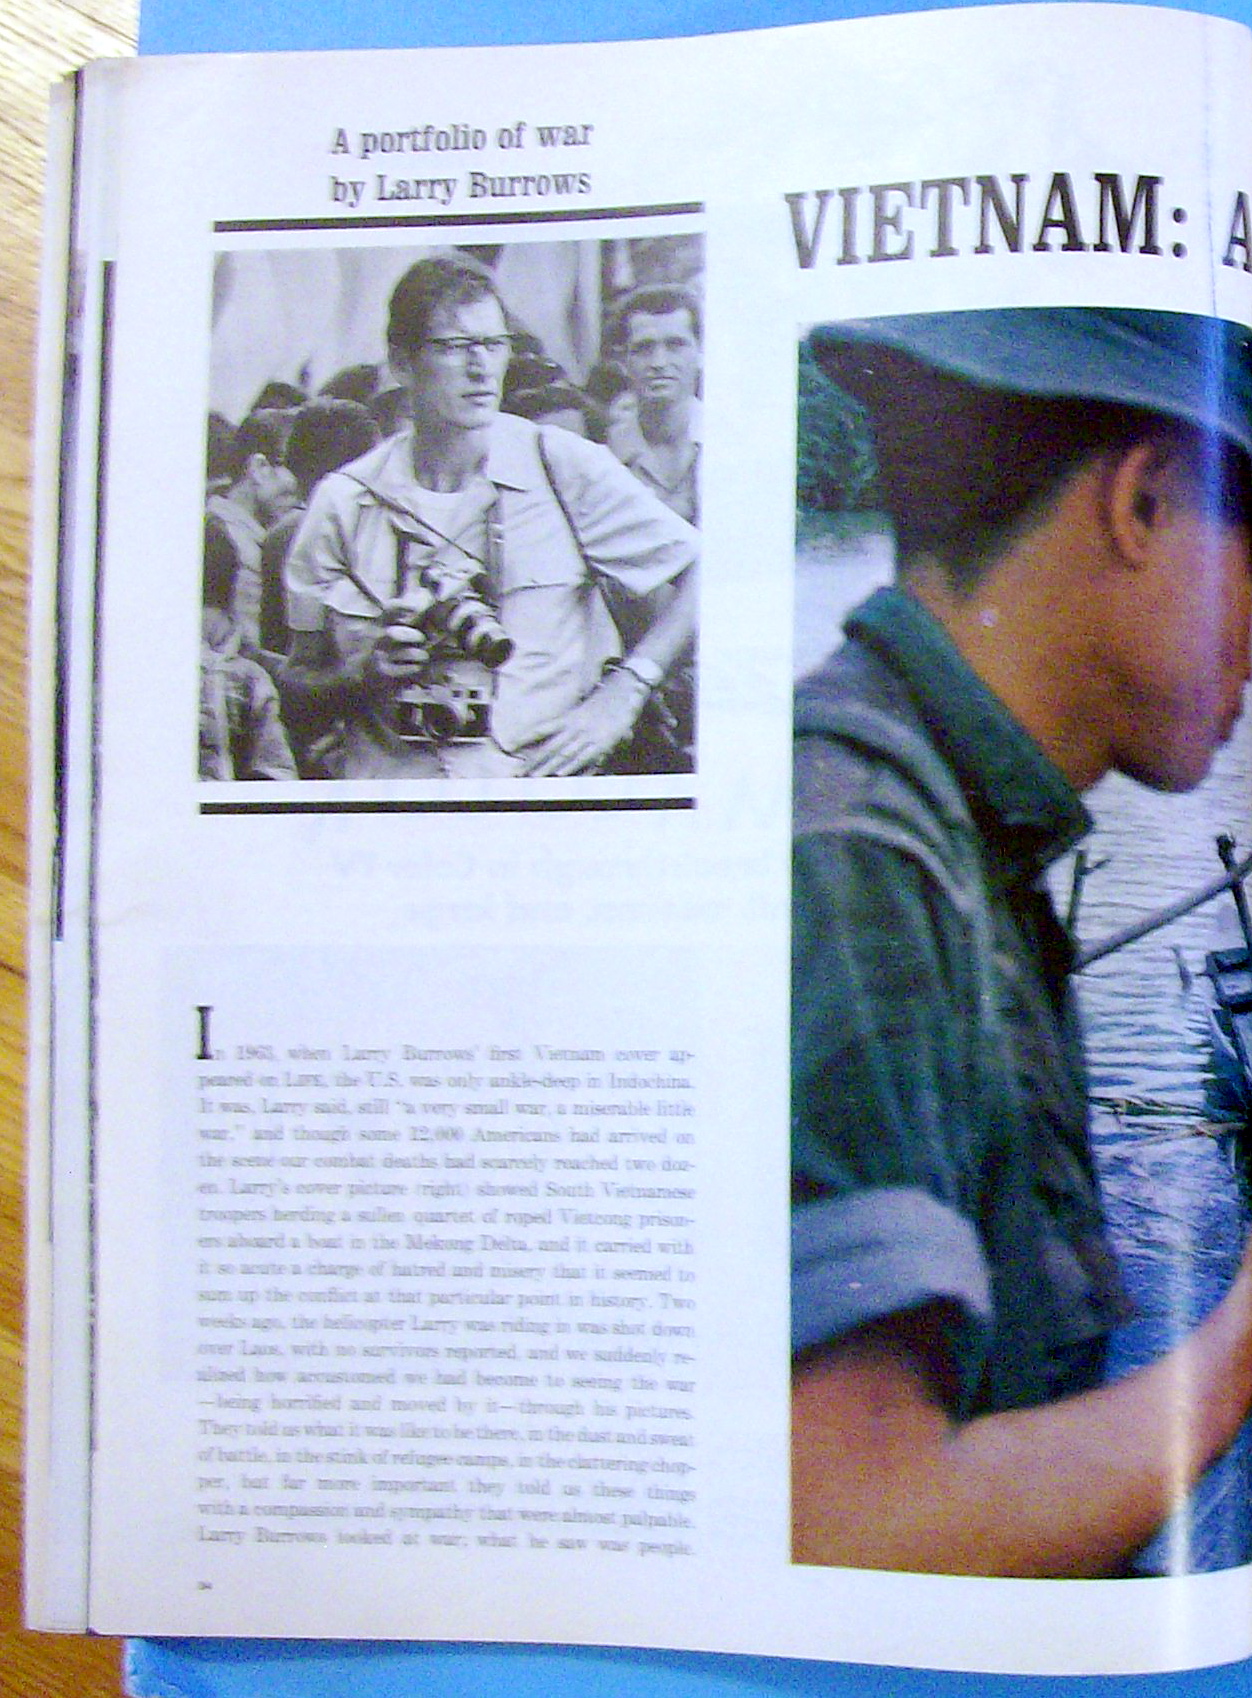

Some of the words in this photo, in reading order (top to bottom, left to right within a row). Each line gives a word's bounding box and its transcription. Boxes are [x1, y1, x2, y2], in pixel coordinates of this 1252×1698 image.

[331, 127, 350, 154] A
[360, 122, 488, 160] portfolio
[498, 120, 527, 150] of
[537, 123, 595, 148] war
[330, 175, 366, 208] by
[376, 172, 458, 206] Larry
[468, 171, 592, 199] Burrows
[784, 171, 1189, 270] VIETNAM:
